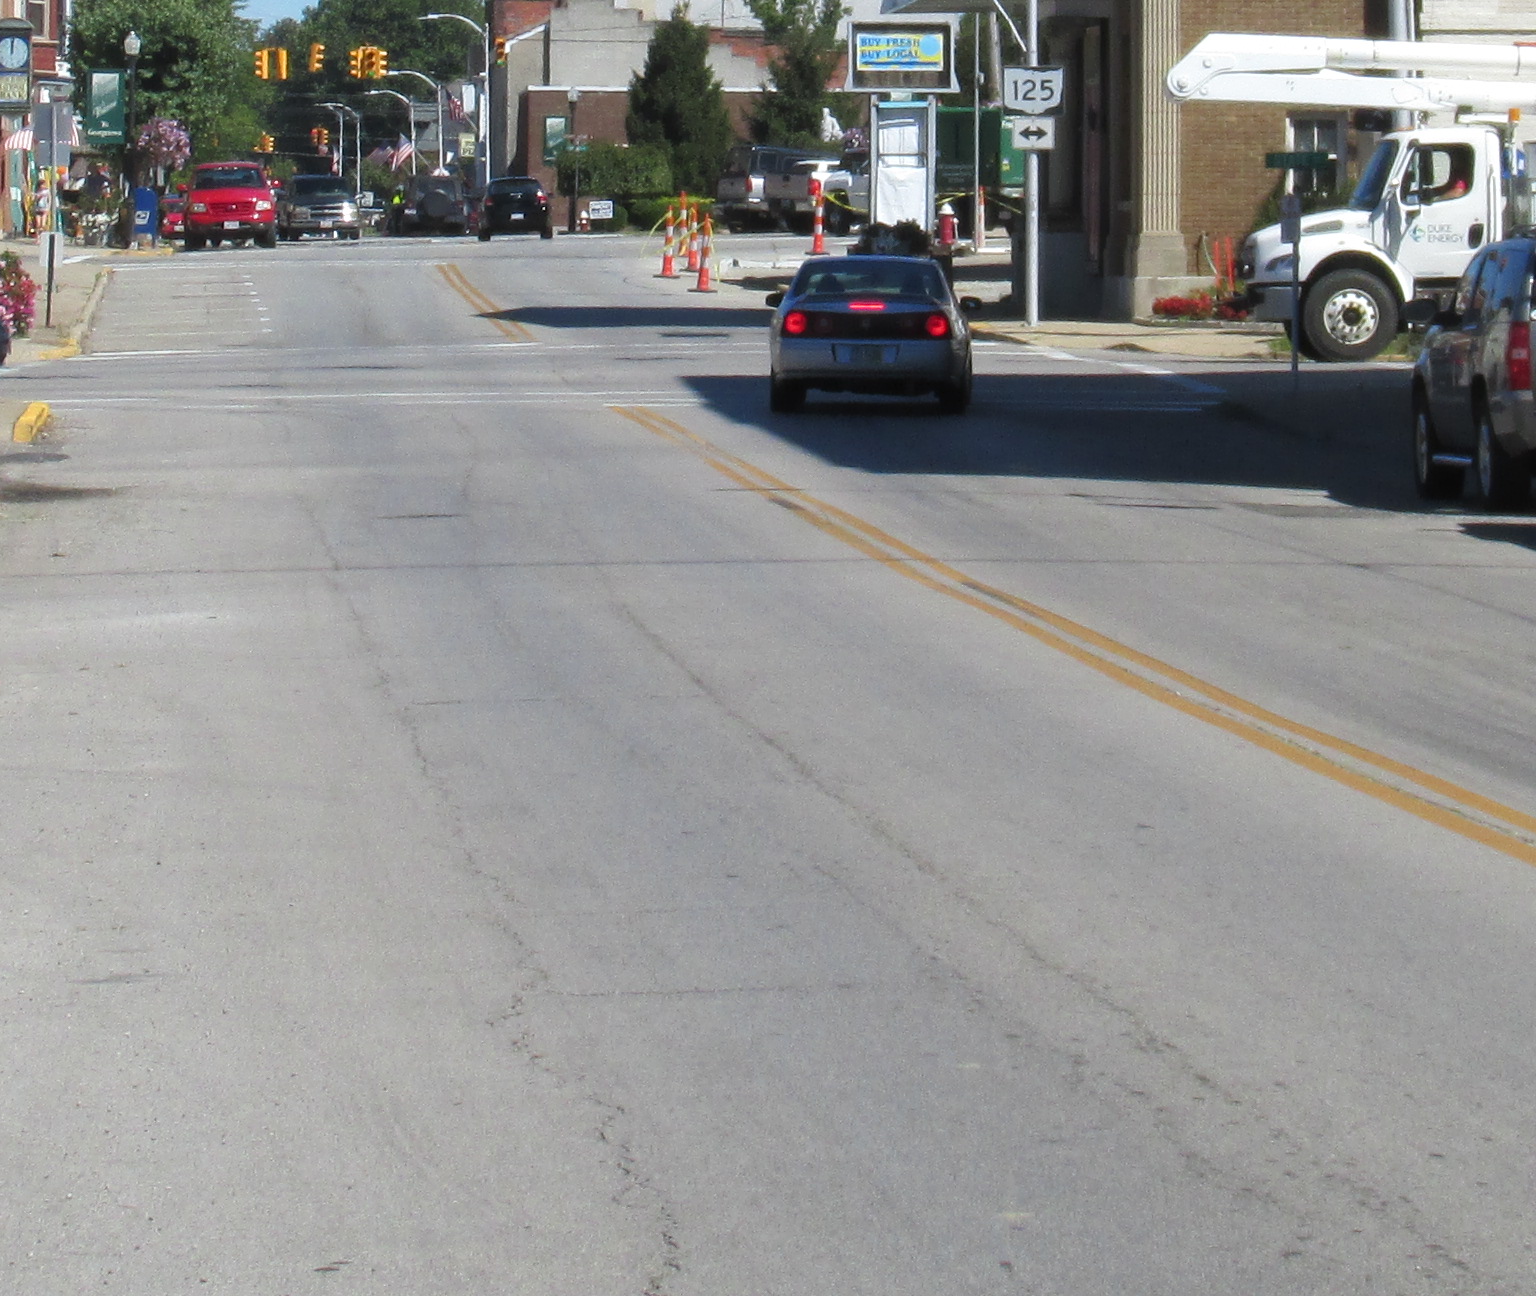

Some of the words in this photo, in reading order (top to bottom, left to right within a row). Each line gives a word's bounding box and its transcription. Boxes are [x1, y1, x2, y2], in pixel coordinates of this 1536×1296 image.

[861, 37, 881, 47] BUY
[886, 37, 920, 47] FRESH
[861, 50, 881, 59] BUY
[886, 49, 919, 59] LOCAL
[1012, 79, 1055, 102] 125
[1427, 224, 1453, 234] DUKE
[1427, 234, 1463, 244] ENERGY
